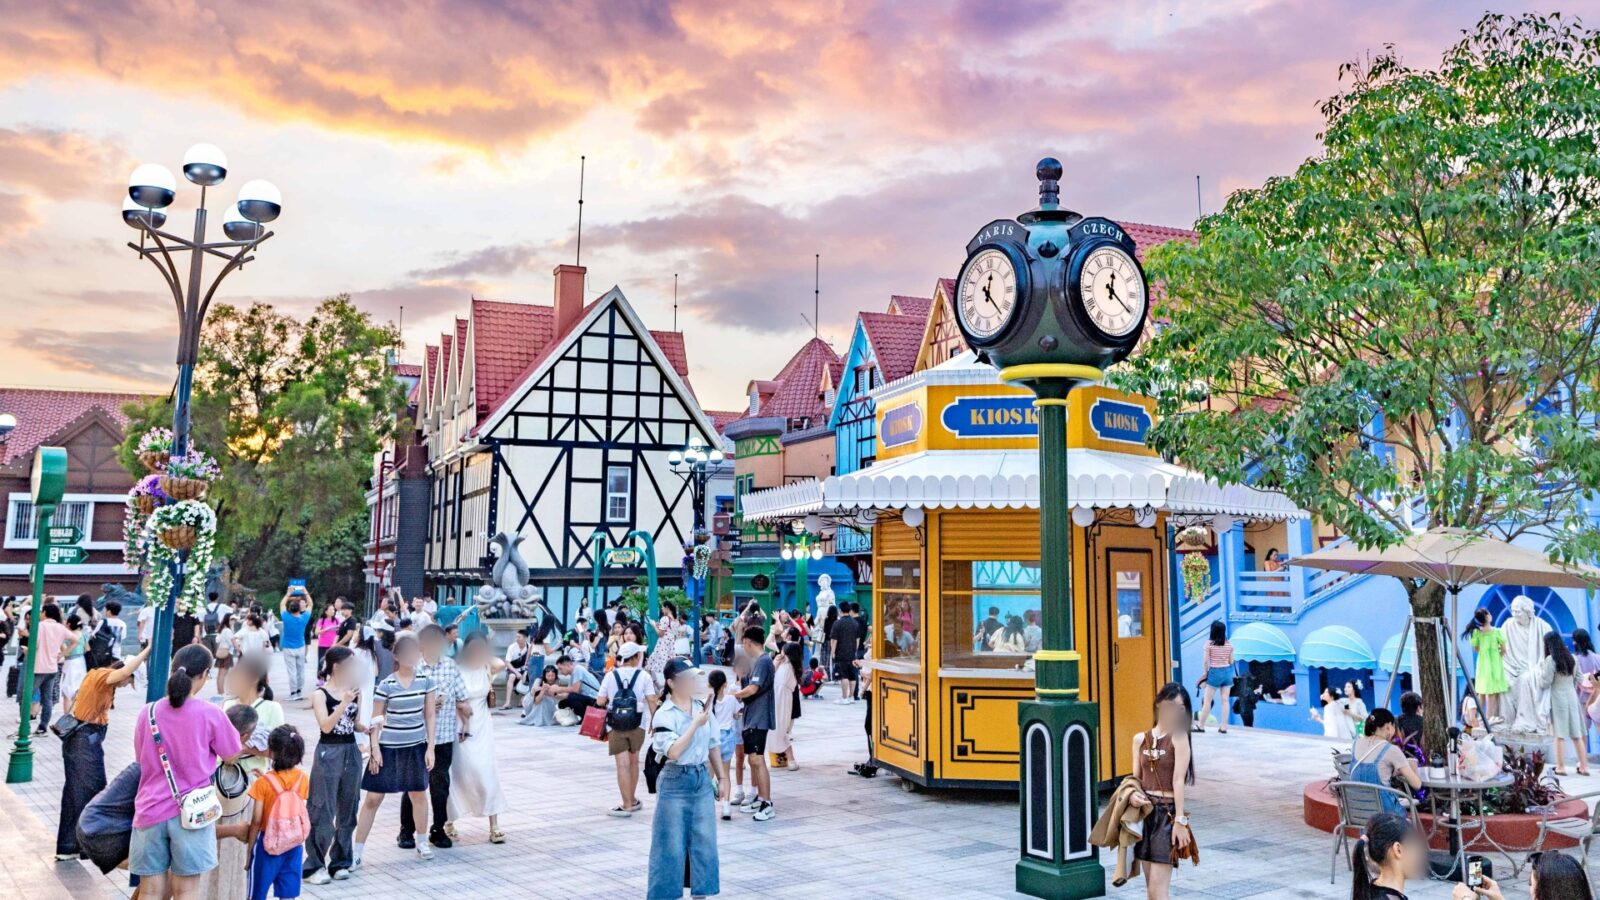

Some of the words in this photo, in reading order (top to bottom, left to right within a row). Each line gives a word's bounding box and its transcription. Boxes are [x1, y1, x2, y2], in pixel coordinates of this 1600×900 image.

[977, 225, 1014, 244] PARIS
[1082, 223, 1124, 242] CZECH
[889, 415, 913, 436] KIOSK
[970, 408, 1039, 425] KIOSK
[1104, 411, 1139, 432] KIOSK
